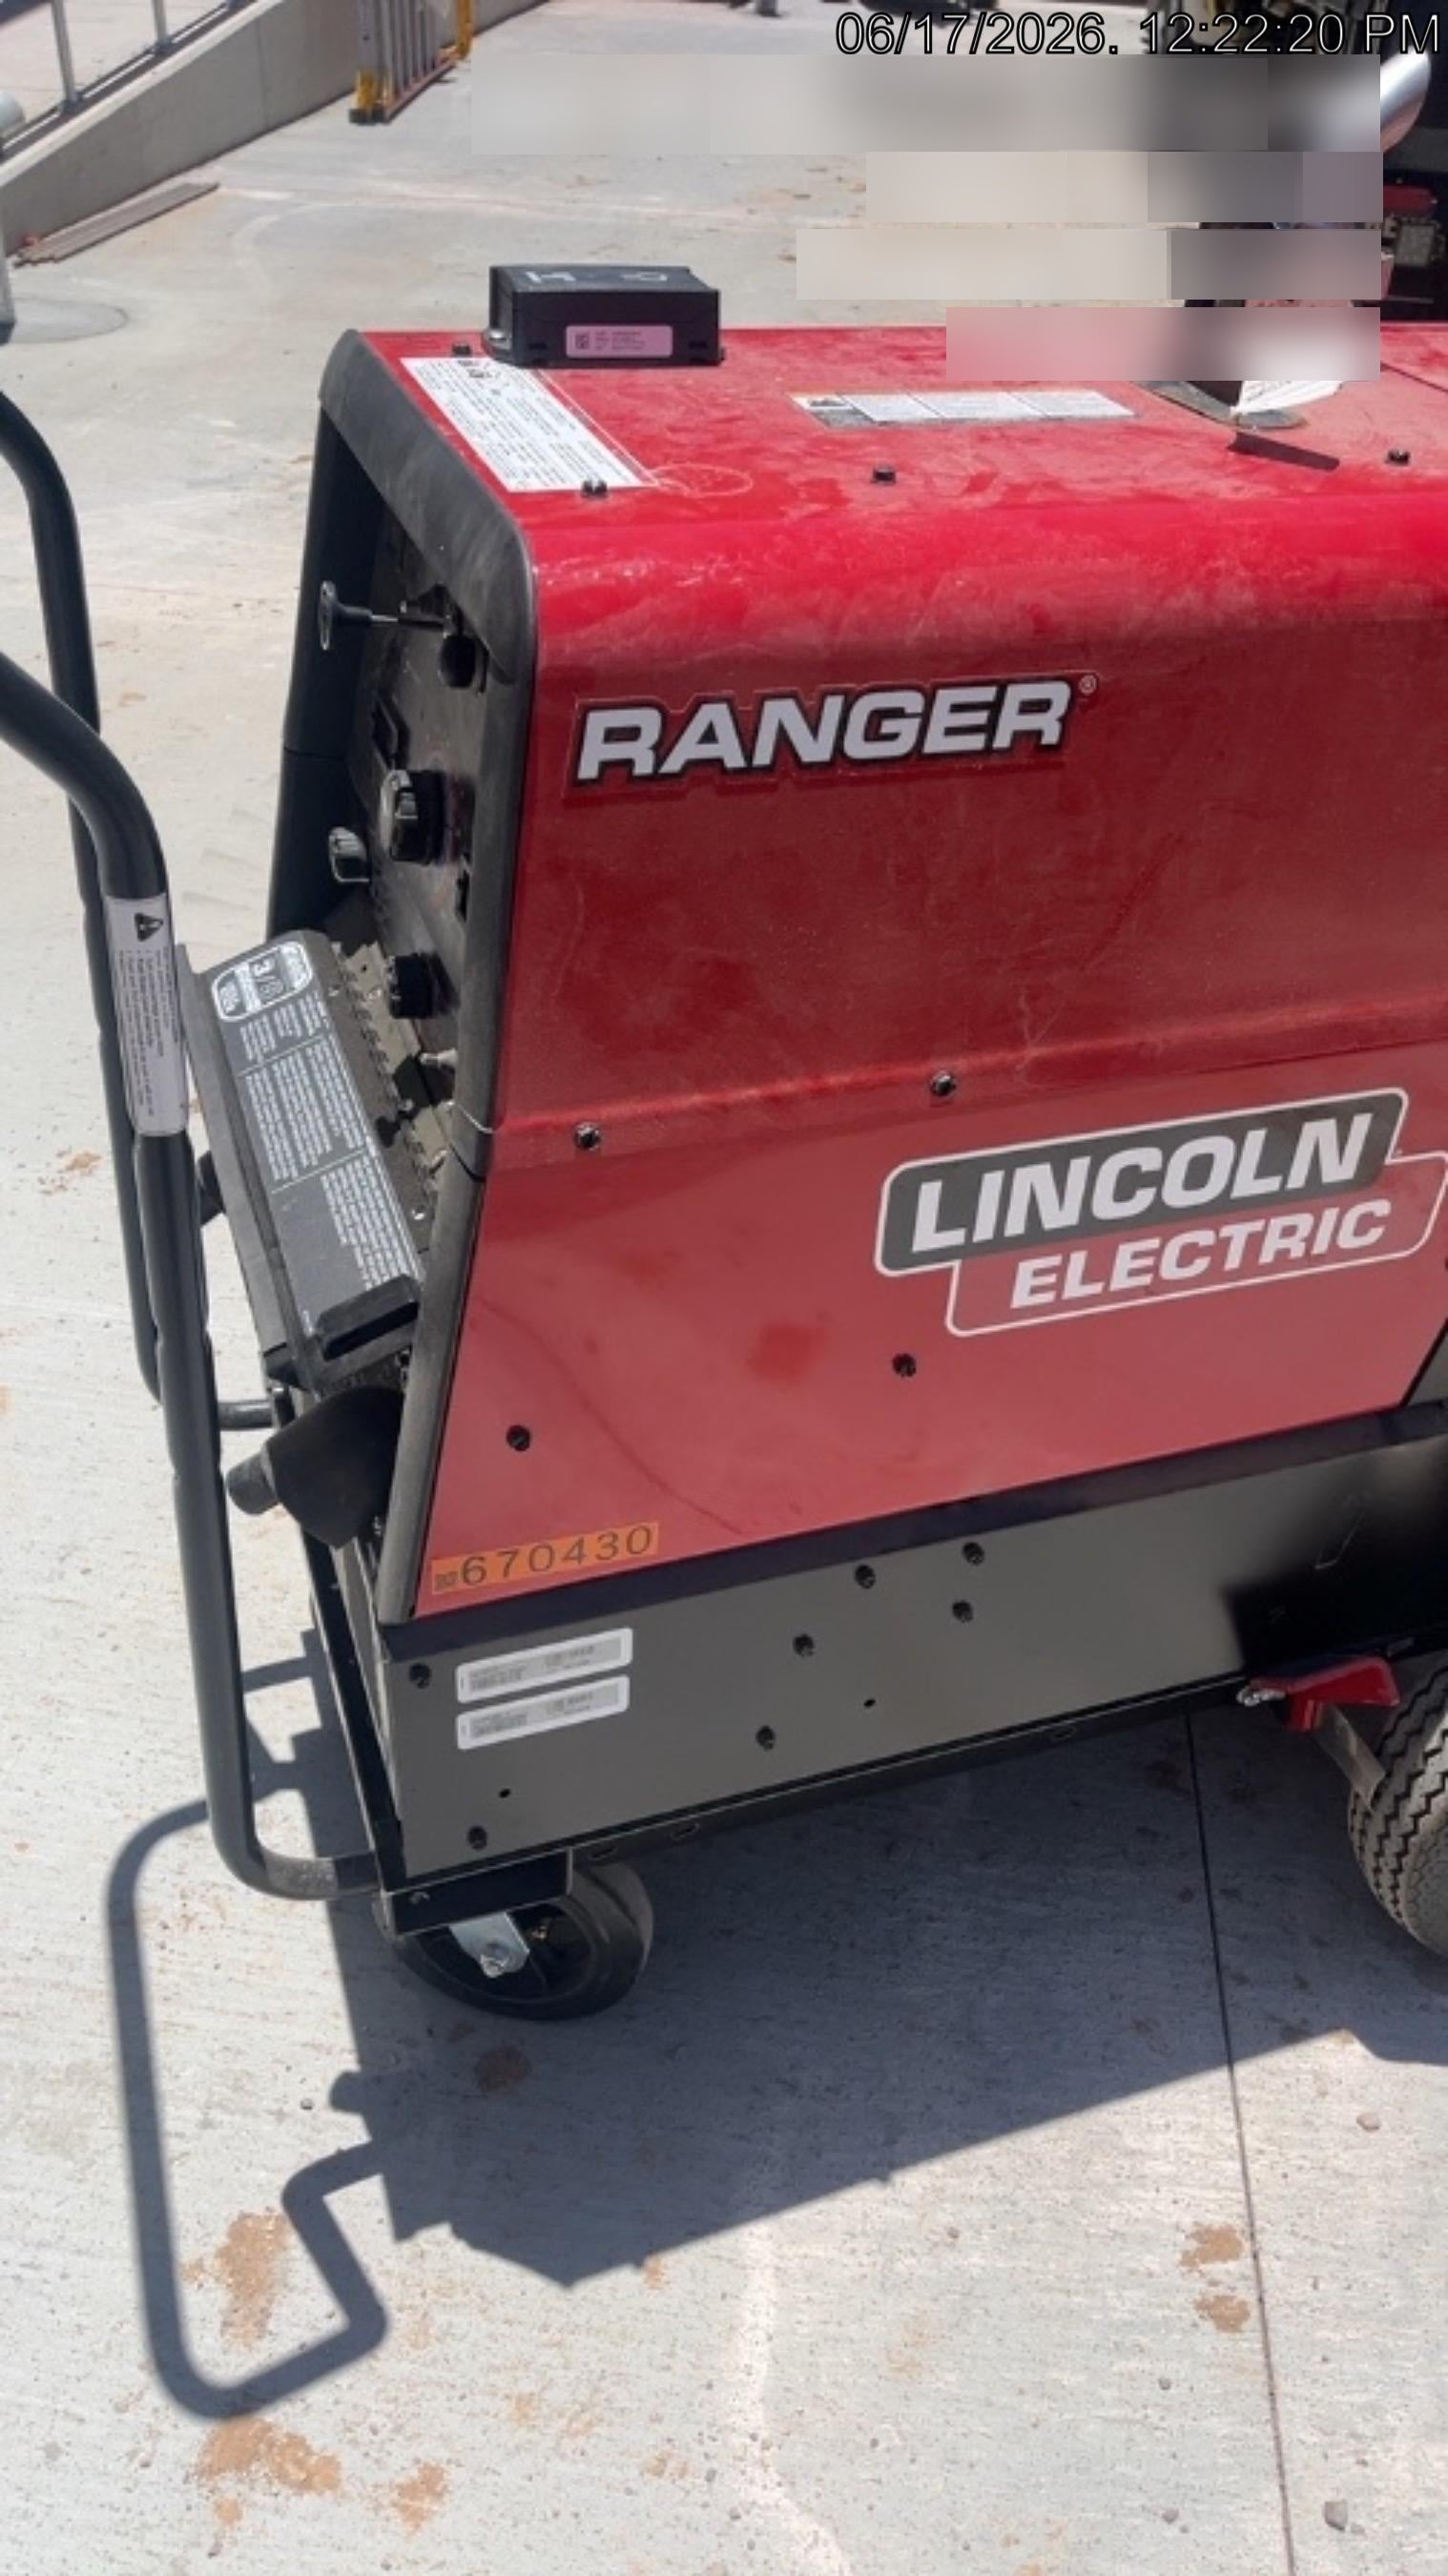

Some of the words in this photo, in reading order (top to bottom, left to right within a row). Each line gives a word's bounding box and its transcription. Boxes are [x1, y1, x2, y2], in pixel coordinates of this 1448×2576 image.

[912, 1112, 1373, 1253] LINCOLN
[1010, 1198, 1393, 1310] ELECTRIC
[461, 1526, 652, 1586] 670430
